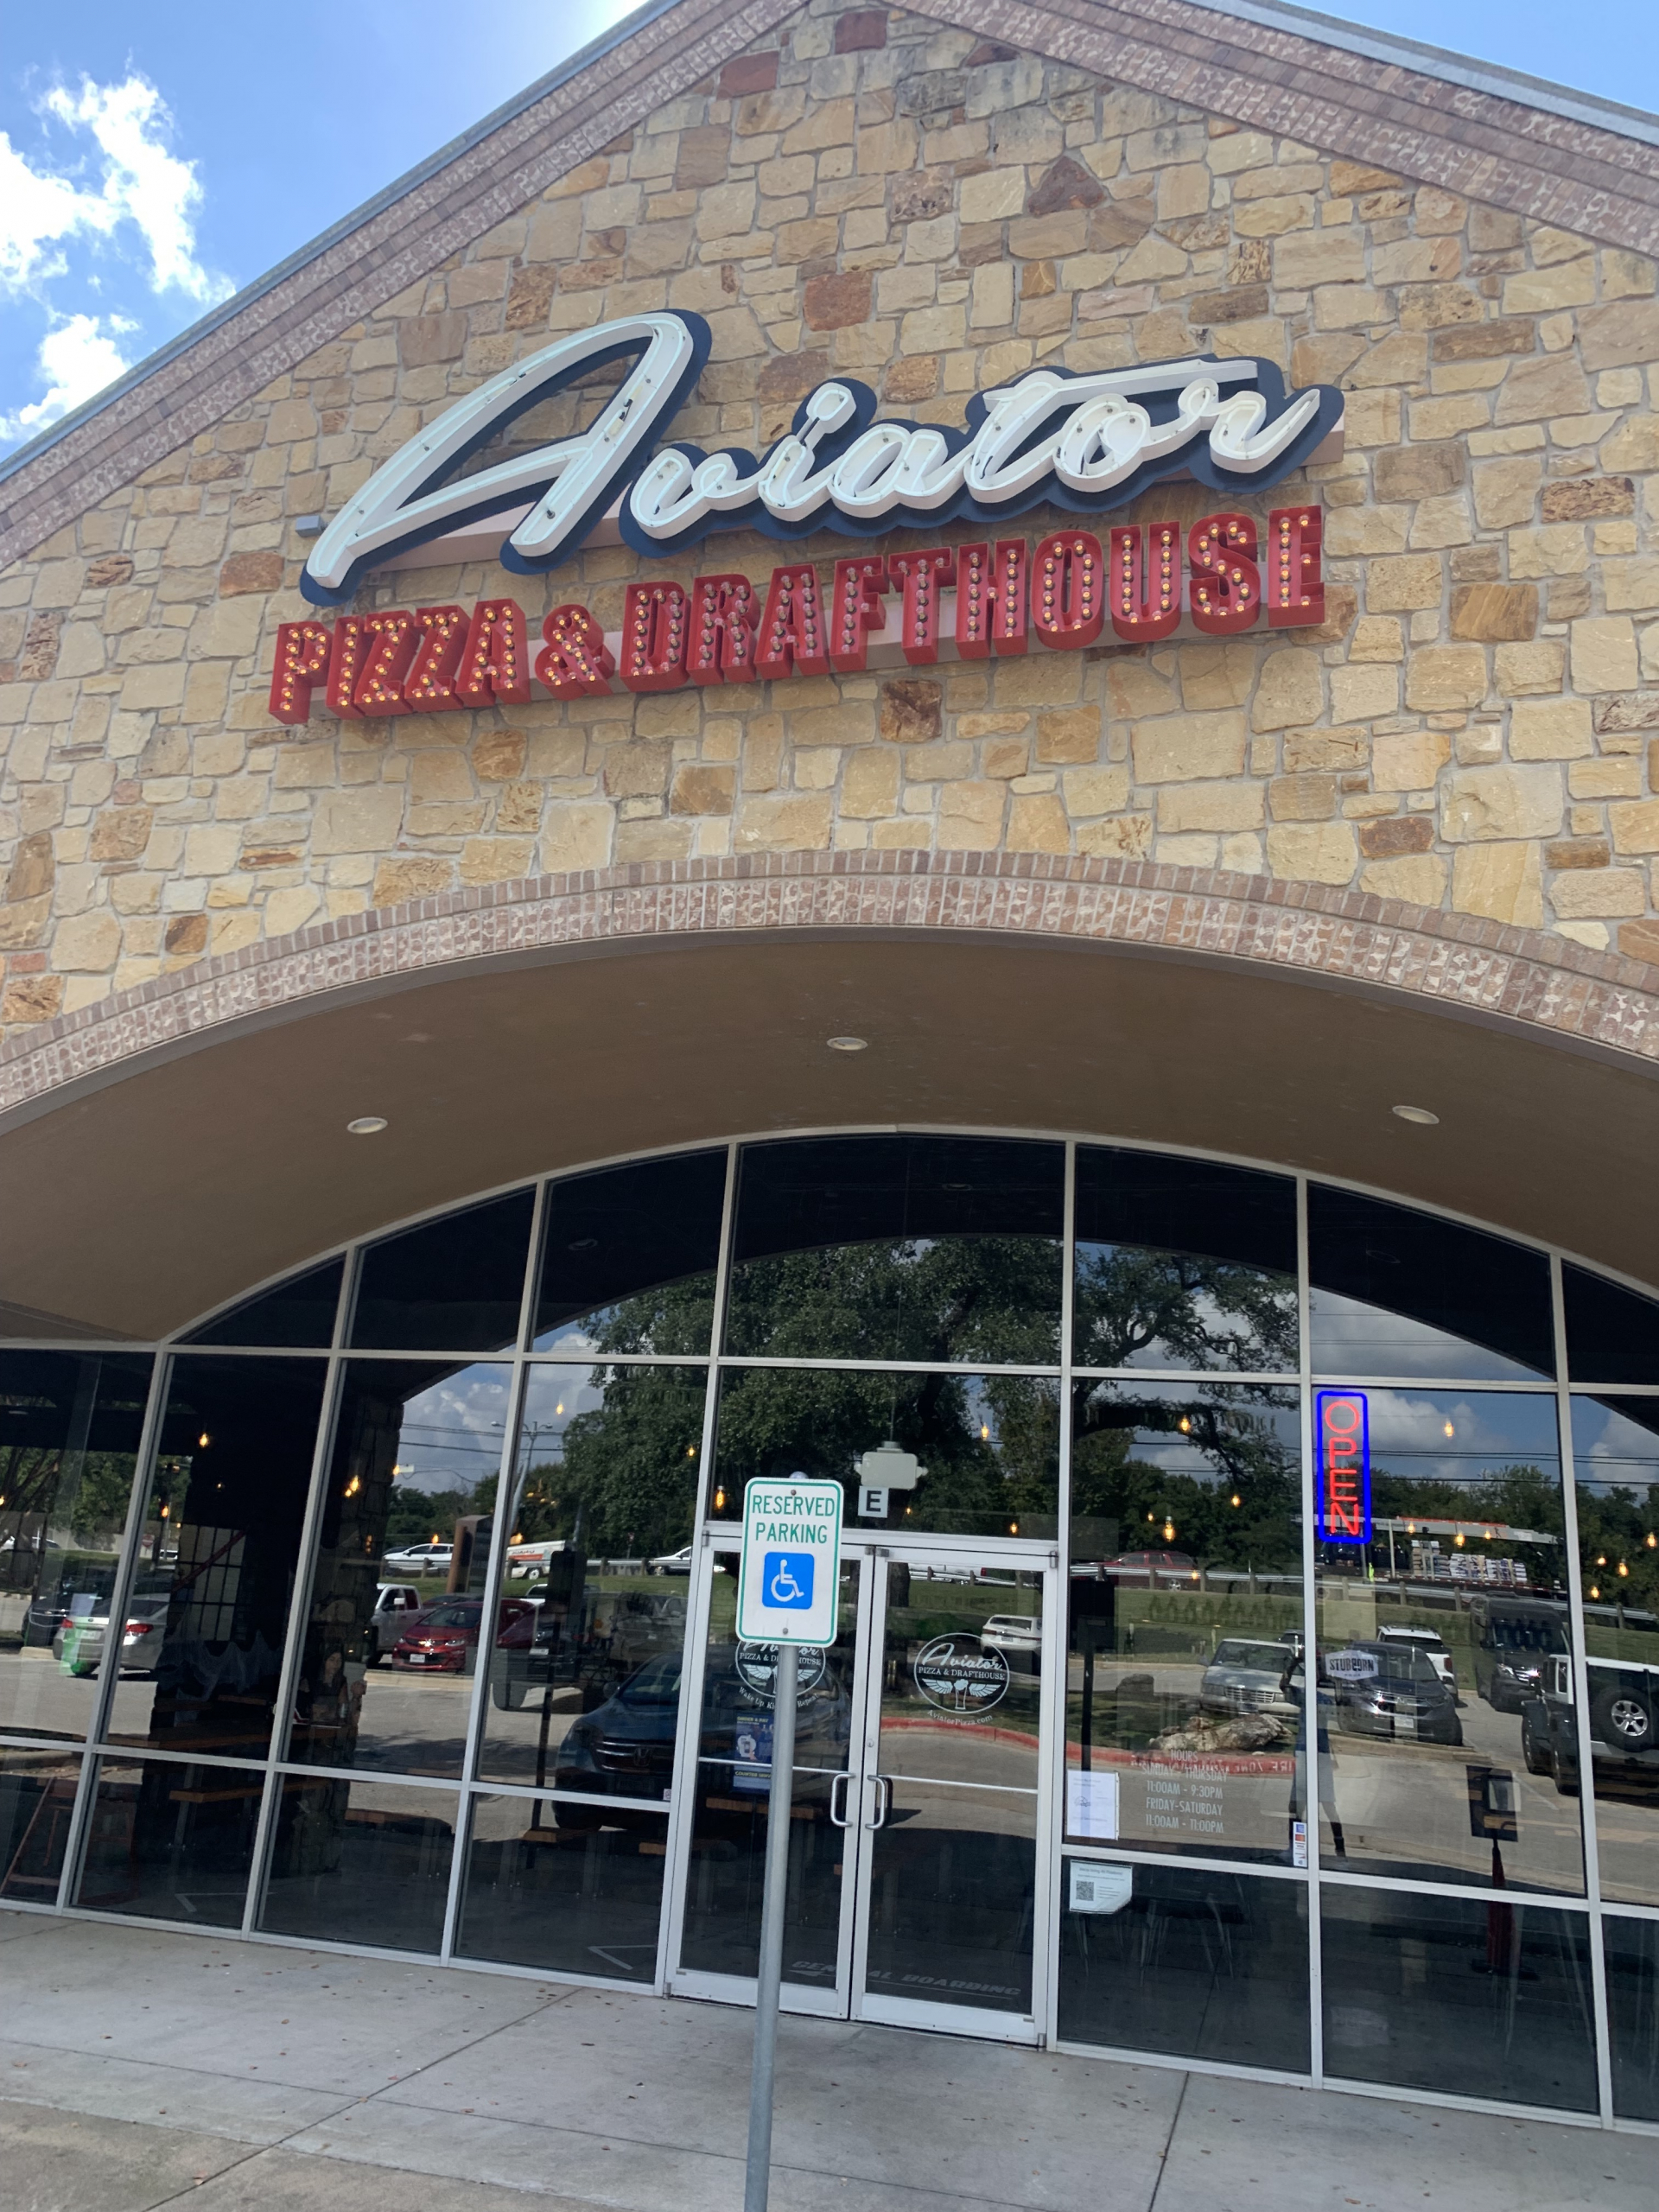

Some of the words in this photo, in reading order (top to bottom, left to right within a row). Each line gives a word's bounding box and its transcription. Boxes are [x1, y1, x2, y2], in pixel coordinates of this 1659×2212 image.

[302, 308, 1332, 594] Aviator
[269, 598, 531, 724] PIZZA
[535, 604, 616, 700] &
[619, 505, 1326, 693] DRAFTHOUSE
[1325, 1400, 1360, 1536] OPEN
[752, 1494, 836, 1516] RESERVED
[866, 1490, 882, 1512] E
[755, 1522, 828, 1544] PARKING
[740, 1652, 761, 1661] PIZZA
[921, 1643, 1002, 1669] Aviator
[1329, 1657, 1375, 1672] STUBBORN
[918, 1667, 942, 1675] PIZZA
[951, 1669, 1005, 1680] DRAFTHOUSE
[739, 1686, 754, 1702] Wake
[927, 1709, 993, 1726] AviatorPizza.com
[1171, 1749, 1198, 1763] HOURS
[1141, 1761, 1173, 1777] SUNDAY
[1184, 1766, 1228, 1783] THURSDAY
[1147, 1780, 1180, 1795] 11:00AM
[1191, 1784, 1224, 1799] 9:30PM
[1145, 1814, 1179, 1829] 11:00AM
[1190, 1818, 1224, 1833] 11:00PM
[901, 1974, 1021, 1996] BOARDING
